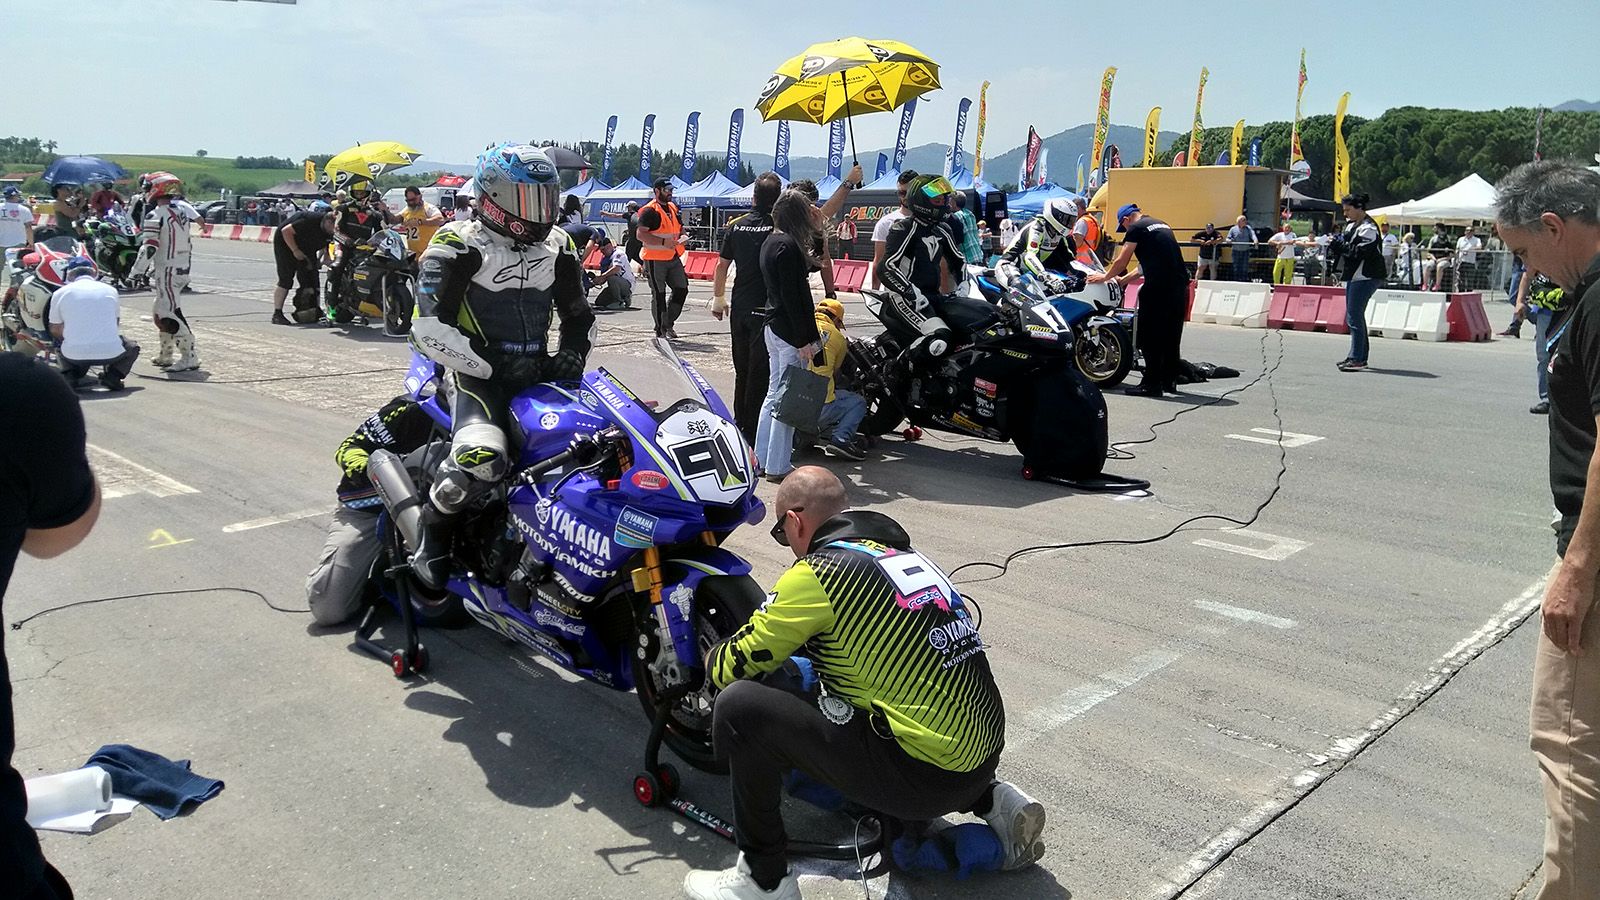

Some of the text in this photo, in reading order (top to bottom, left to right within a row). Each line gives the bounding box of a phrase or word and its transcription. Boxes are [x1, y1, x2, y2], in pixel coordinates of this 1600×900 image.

[604, 126, 613, 163] YAMAHA
[641, 125, 651, 160] YAMAHA
[684, 123, 695, 160] YAMAHA
[728, 121, 739, 159] YAMAHA
[897, 110, 911, 153] YAMAHA
[955, 111, 967, 153] YAMAHA
[608, 203, 628, 213] YAMA
[592, 379, 625, 411] YAMAHA
[551, 505, 612, 561] YAMAHA
[630, 514, 654, 530] YAMAHA
